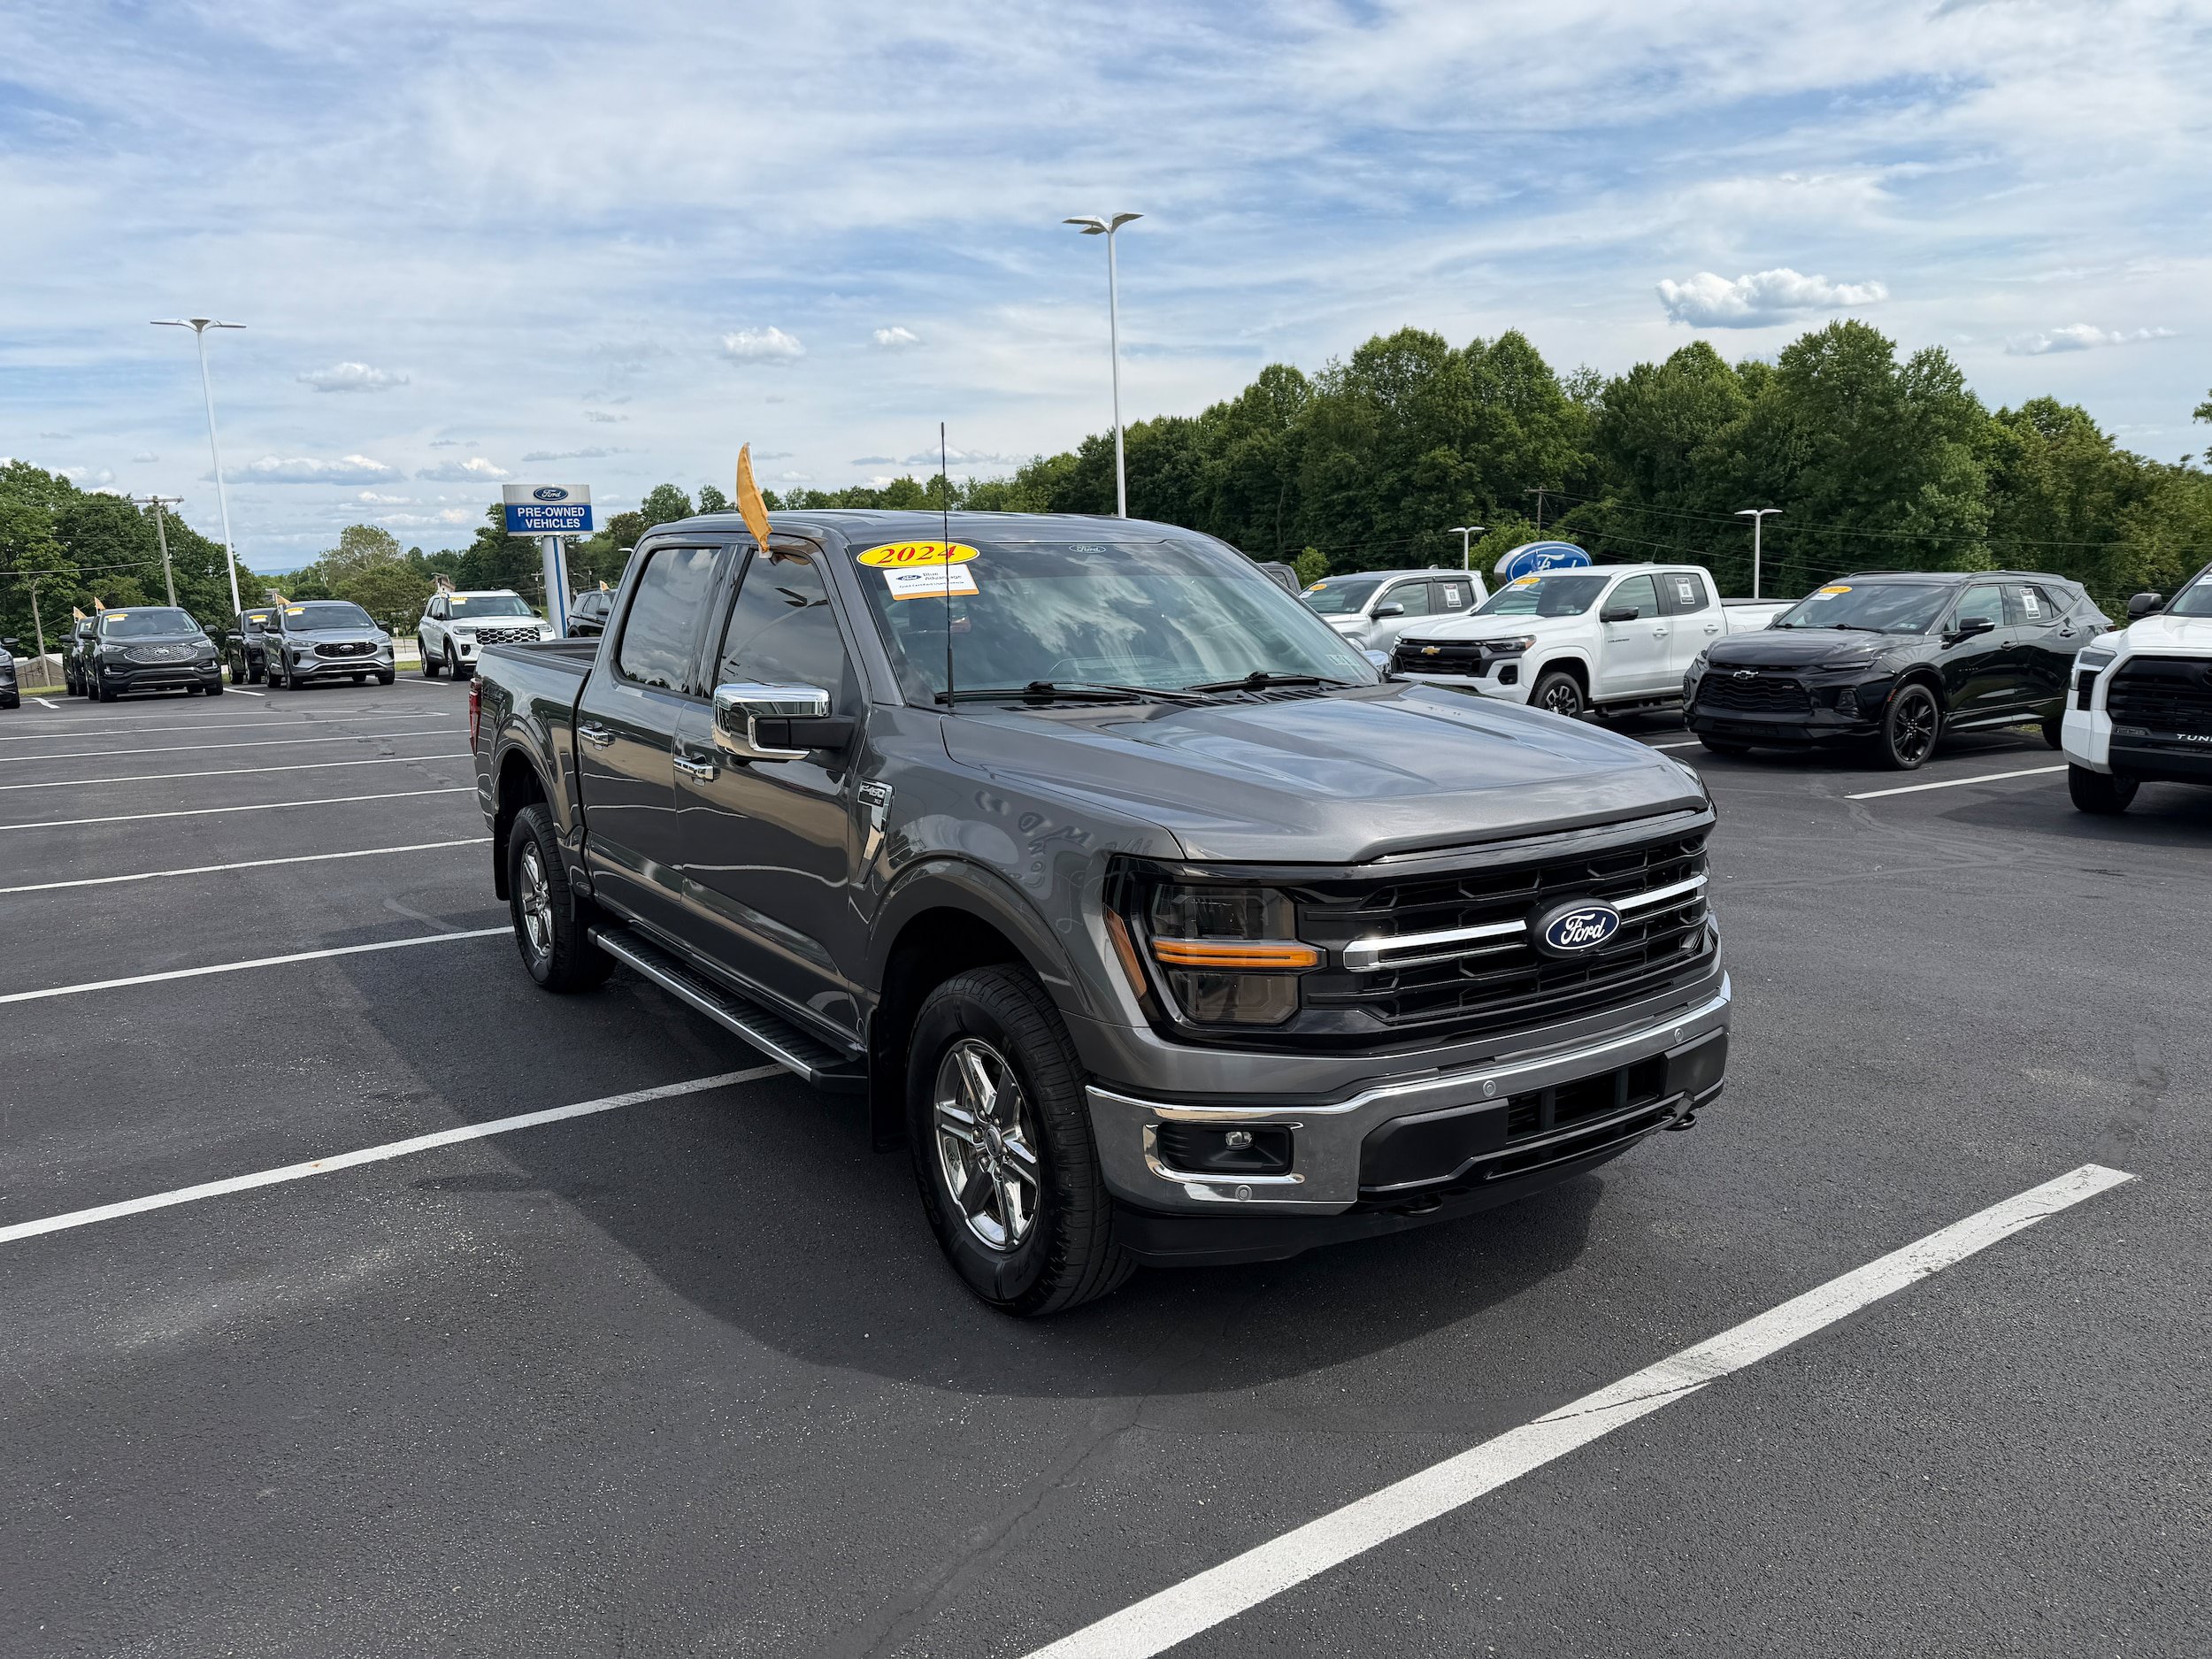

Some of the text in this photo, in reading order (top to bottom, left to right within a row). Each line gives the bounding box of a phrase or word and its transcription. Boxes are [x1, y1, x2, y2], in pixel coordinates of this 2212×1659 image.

[517, 507, 585, 518] PRE-OWNED
[525, 518, 580, 528] VEHICLES
[876, 545, 957, 565] 2024
[2177, 733, 2212, 742] TUN
[1560, 913, 1607, 945] Ford
